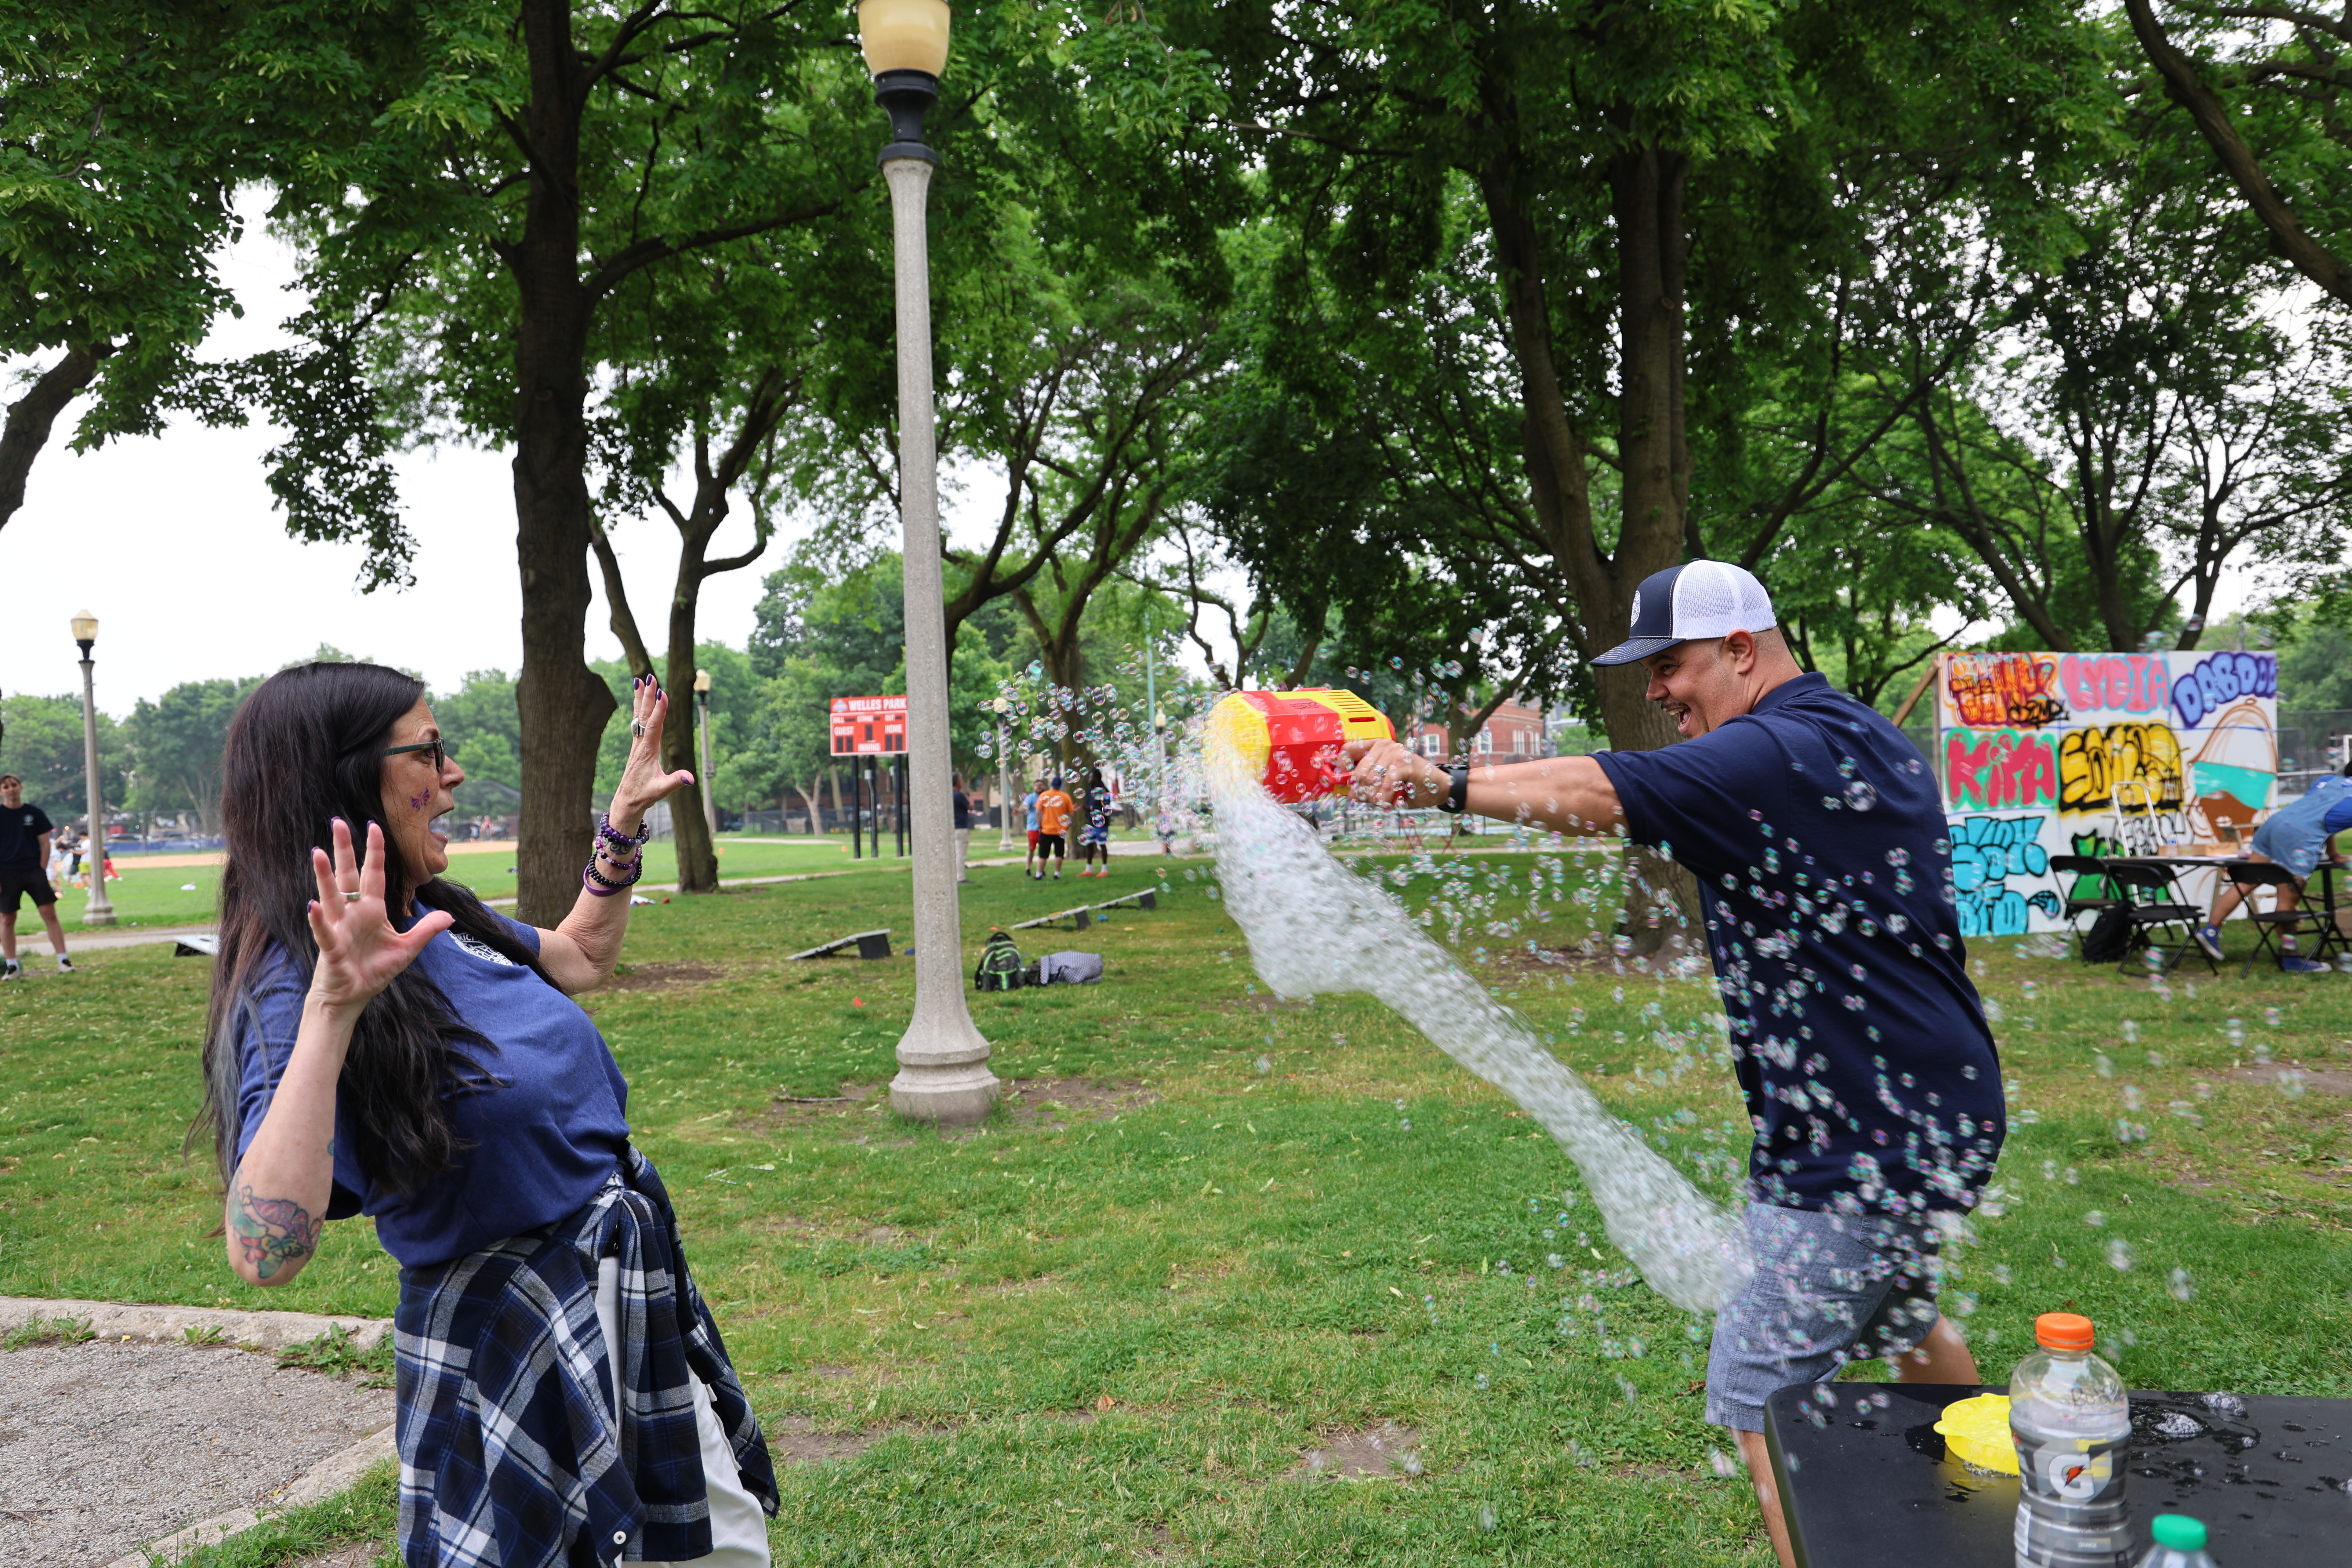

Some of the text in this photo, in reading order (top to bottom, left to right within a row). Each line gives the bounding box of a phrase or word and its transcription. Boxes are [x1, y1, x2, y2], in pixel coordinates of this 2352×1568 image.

[849, 698, 907, 711] WELLES PARK
[834, 726, 855, 736] GUEST
[885, 724, 903, 733] HOME
[858, 743, 881, 752] INNING
[2049, 1454, 2095, 1499] G
